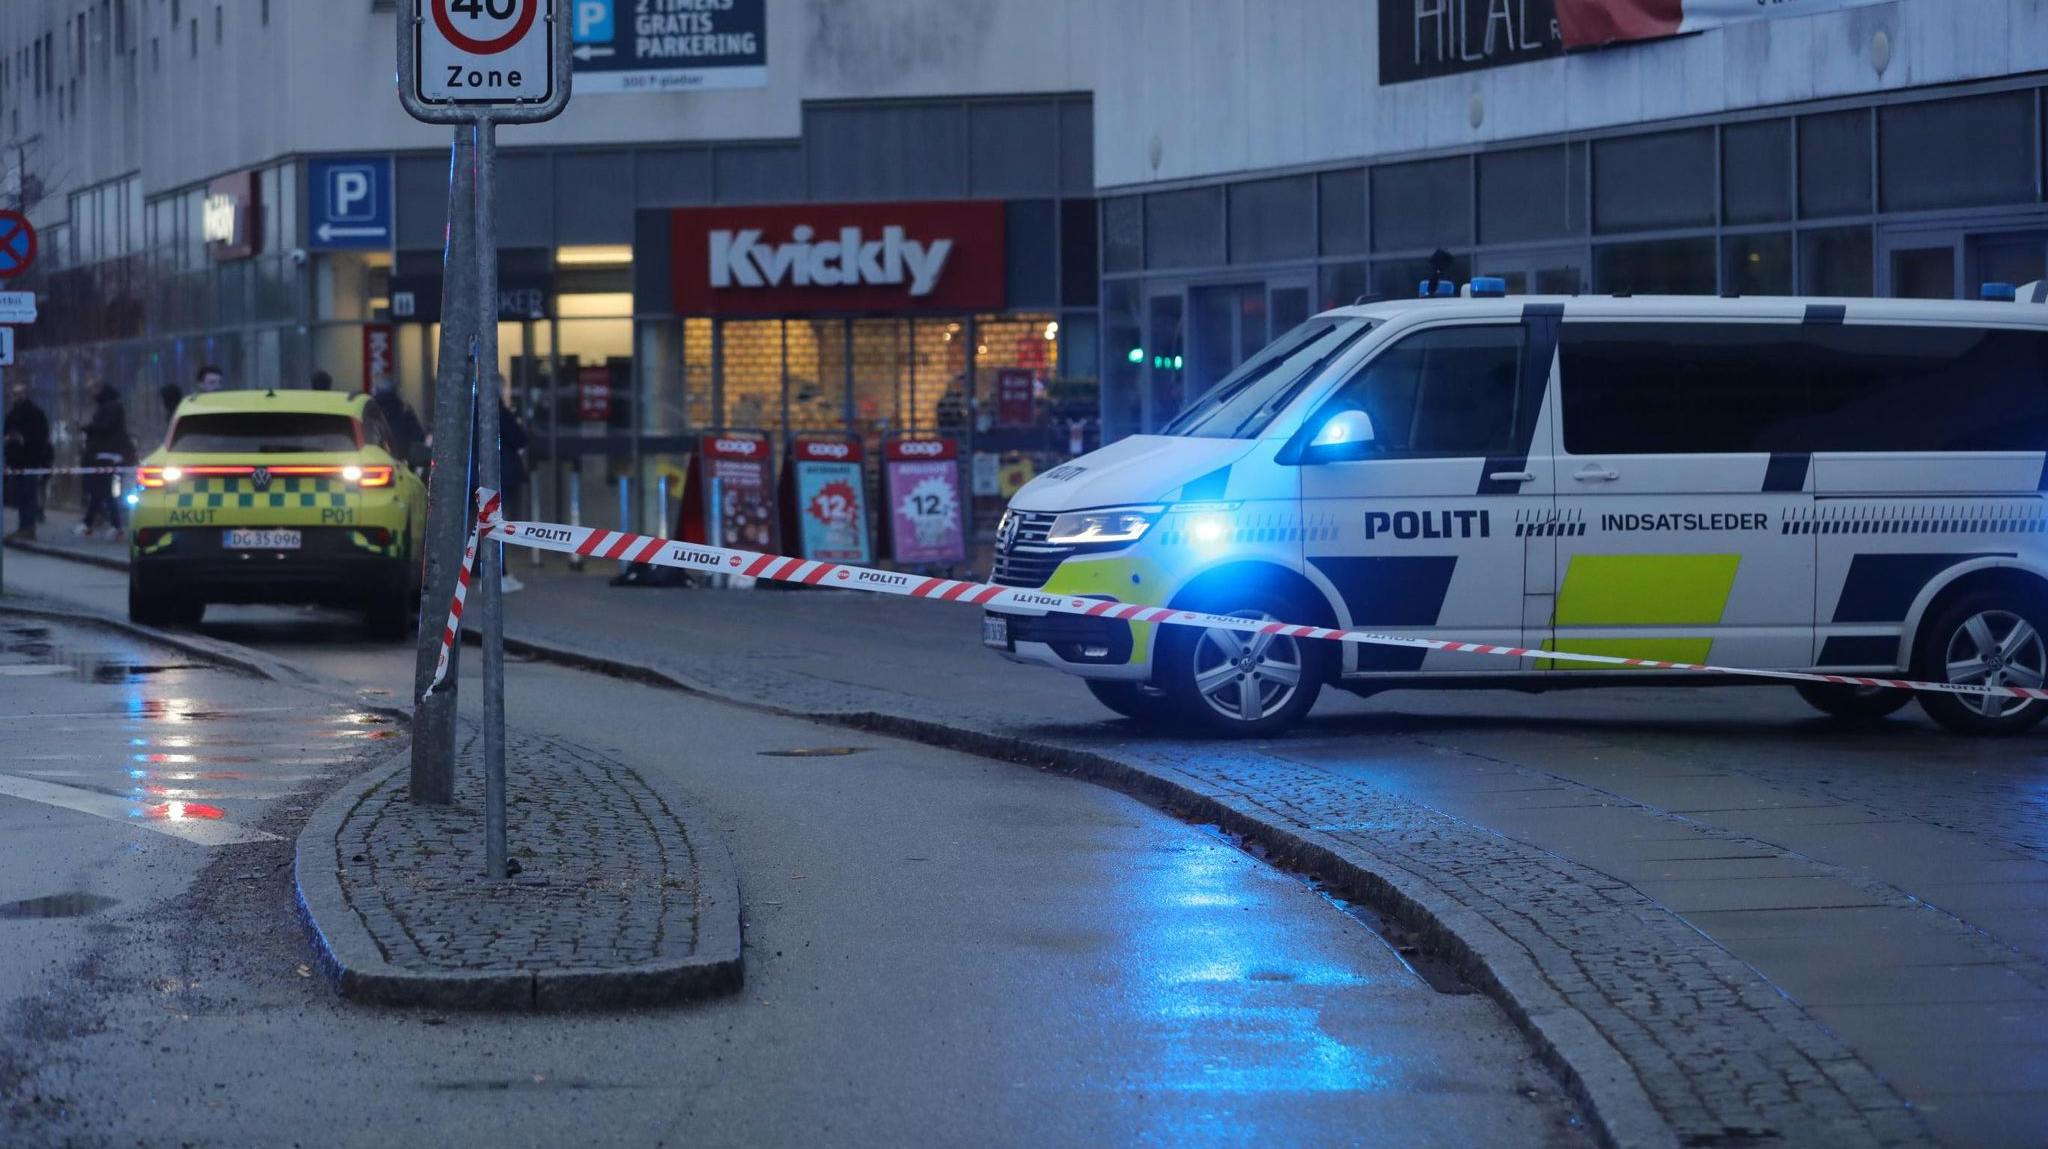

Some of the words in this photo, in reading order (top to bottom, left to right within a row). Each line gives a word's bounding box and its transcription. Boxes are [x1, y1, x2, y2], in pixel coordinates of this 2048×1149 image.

[451, 0, 516, 20] 40
[579, 2, 606, 37] P
[635, 12, 714, 36] GRATIS
[635, 32, 757, 59] PARKERING
[447, 66, 522, 87] Zone
[336, 172, 368, 216] P
[708, 225, 952, 296] Kvickly
[169, 508, 217, 524] AKUT
[321, 508, 354, 524] P01
[1365, 510, 1490, 539] POLITI
[1602, 513, 1768, 531] INDSATSLEDER
[232, 531, 251, 546] DG
[255, 531, 271, 546] 35
[274, 531, 300, 546] 096
[524, 527, 572, 542] POLITI
[673, 550, 720, 565] POLITI
[858, 572, 908, 585] POLITI
[1012, 593, 1062, 607] POLITI
